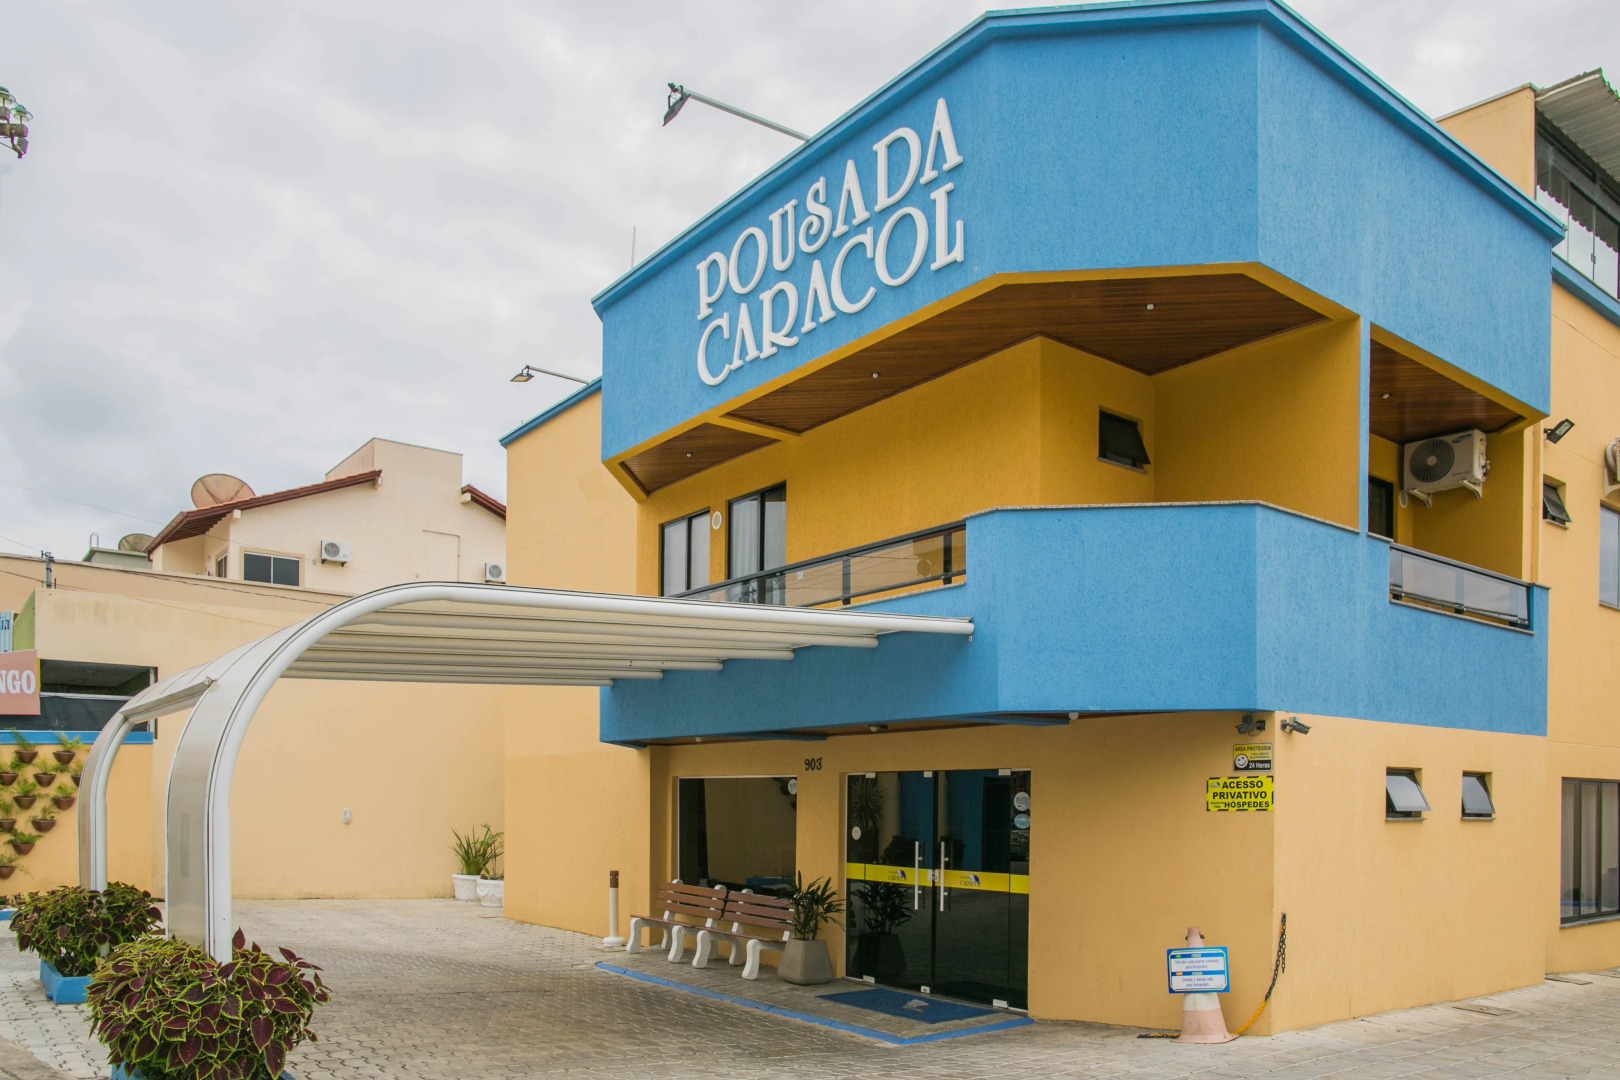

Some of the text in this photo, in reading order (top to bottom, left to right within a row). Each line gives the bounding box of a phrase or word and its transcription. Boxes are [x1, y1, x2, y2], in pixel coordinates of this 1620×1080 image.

[696, 97, 963, 320] POUSADA
[697, 182, 964, 386] CARACOL
[804, 757, 823, 772] 903
[1222, 780, 1264, 789] ACESSO
[1212, 791, 1267, 800] PRIVATIVO
